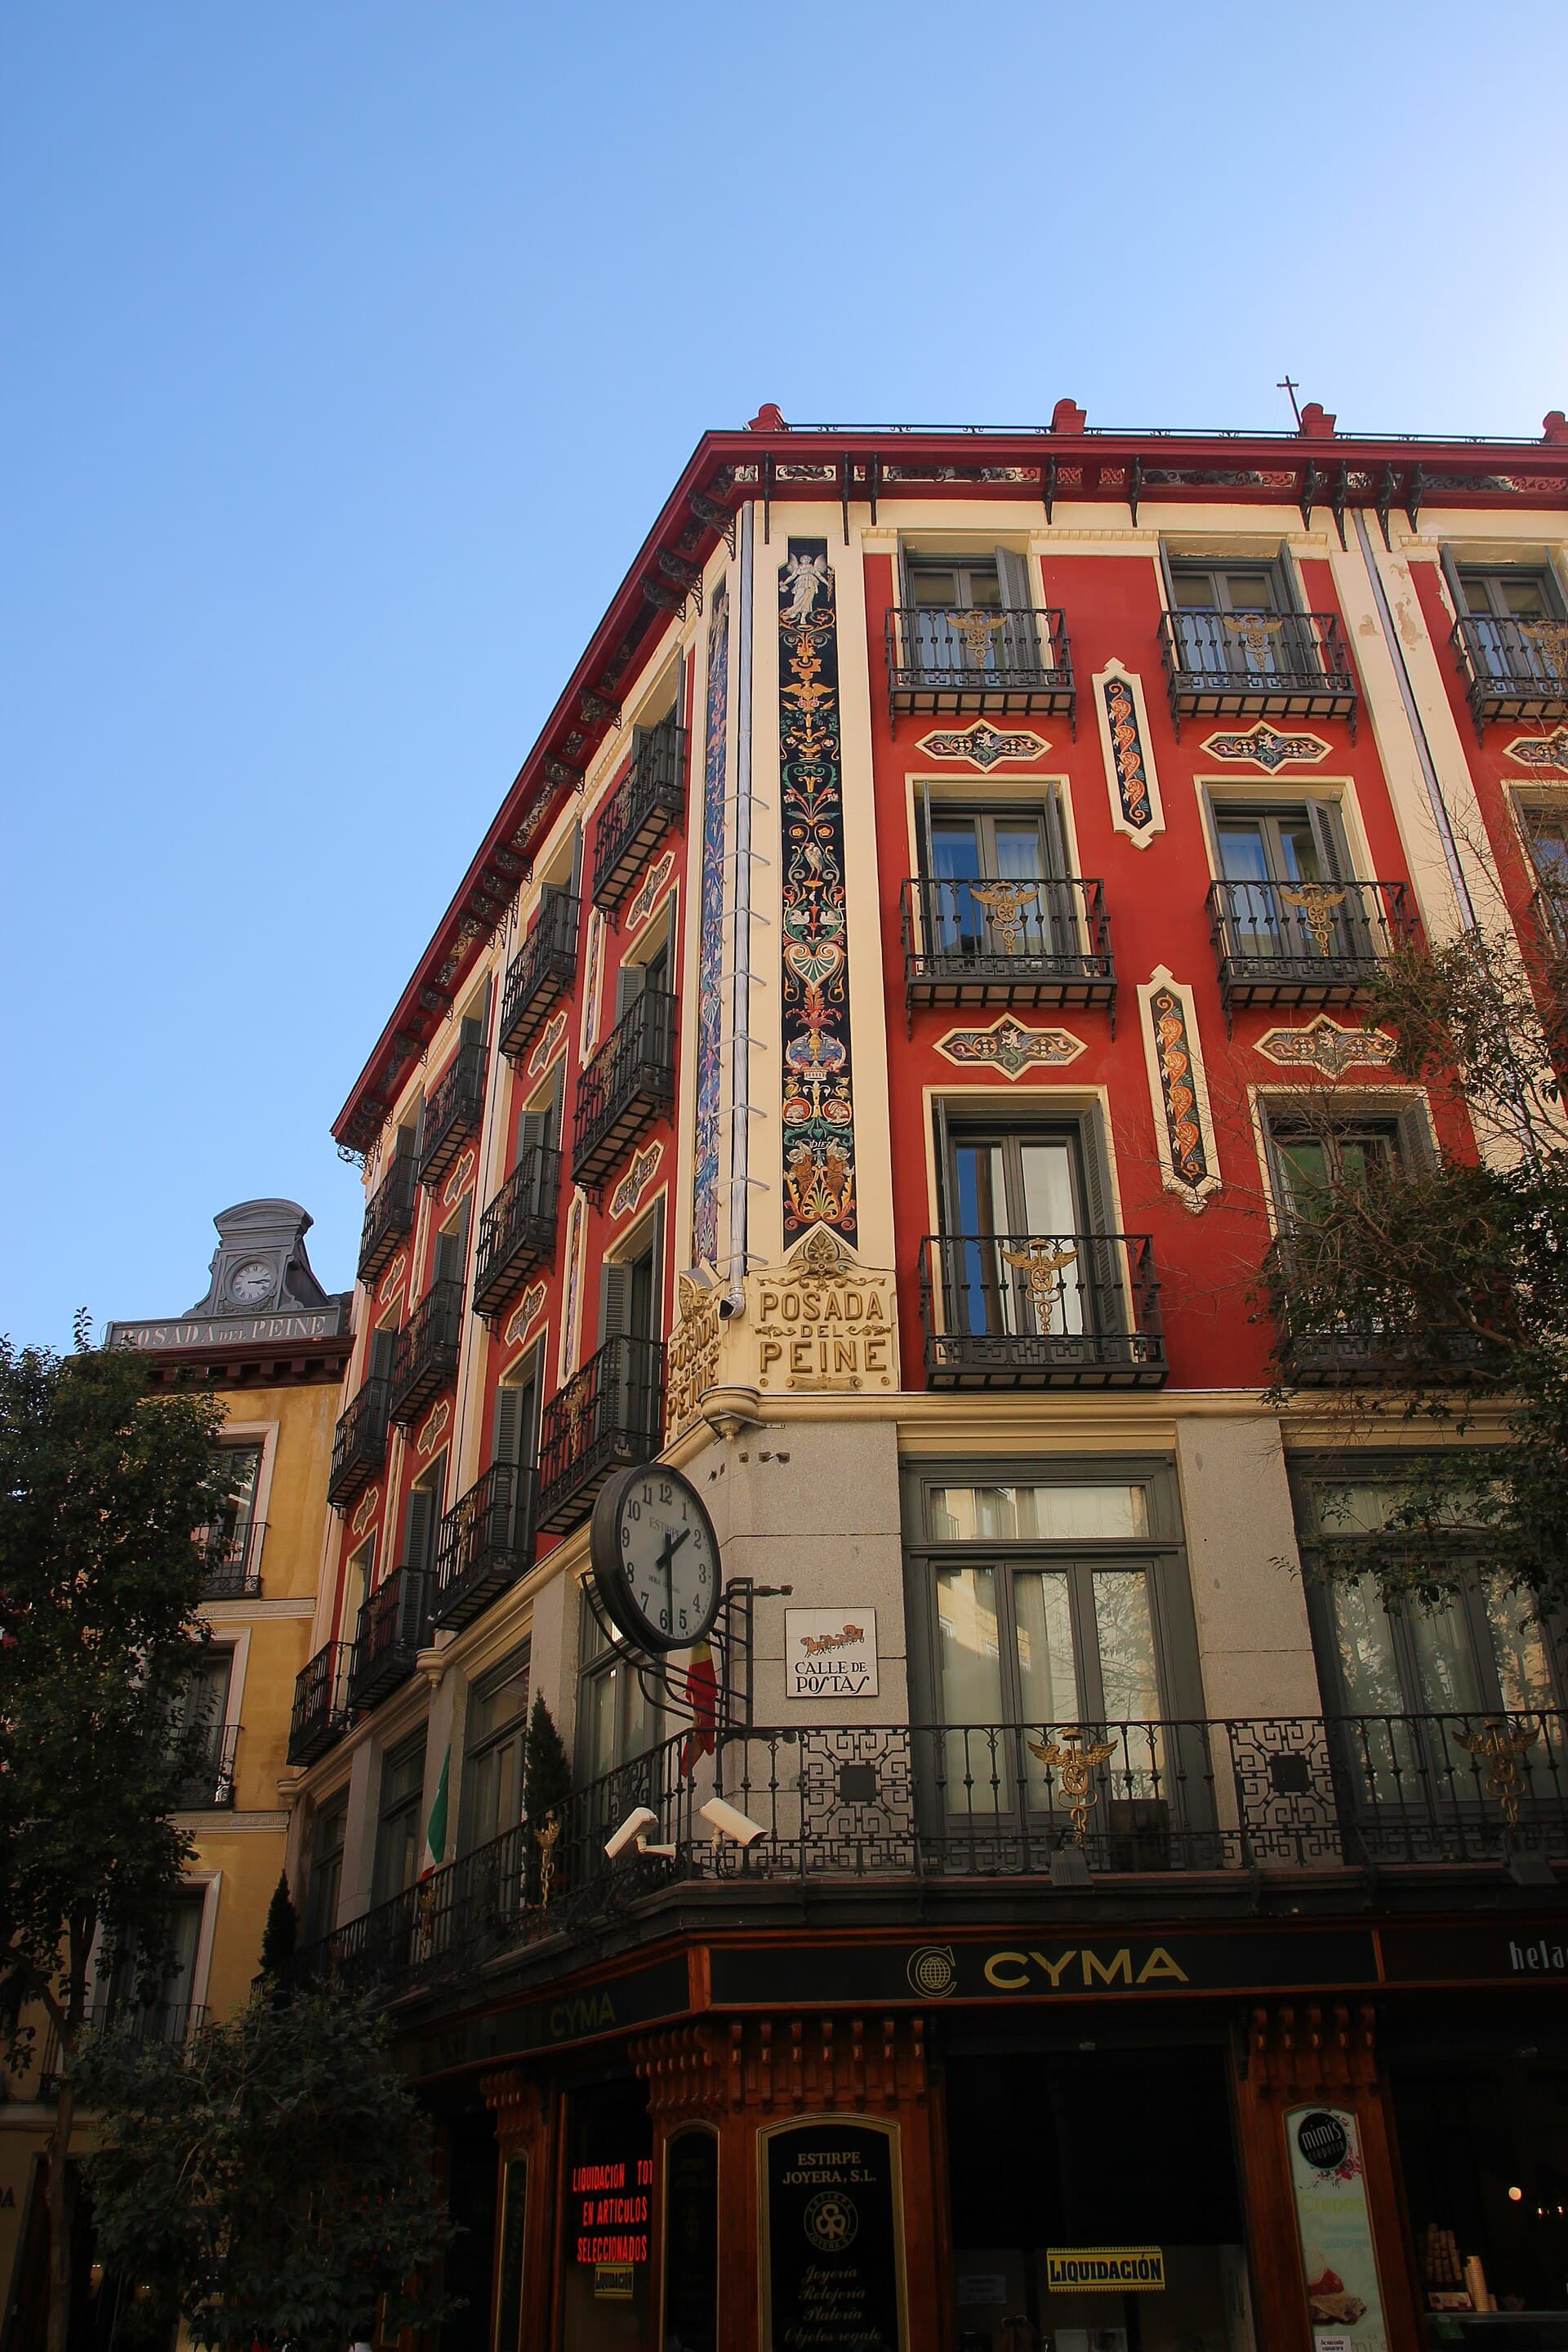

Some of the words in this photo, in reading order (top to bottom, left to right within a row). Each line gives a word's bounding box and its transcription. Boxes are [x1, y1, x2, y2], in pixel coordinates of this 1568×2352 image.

[760, 1291, 884, 1321] POSADA
[218, 1330, 247, 1342] DEL
[252, 1315, 327, 1339] PEINE
[800, 1324, 844, 1338] DEL
[760, 1339, 888, 1374] PEINE
[643, 1484, 653, 1505] 11
[659, 1483, 673, 1506] 12
[627, 1499, 641, 1521] 10
[681, 1502, 688, 1521] 1
[621, 1526, 630, 1548] 9
[693, 1529, 702, 1550] 2
[626, 1561, 635, 1584] 8
[698, 1563, 706, 1584] 3
[640, 1592, 650, 1613] 7
[692, 1593, 701, 1614] 4
[659, 1609, 668, 1630] 6
[679, 1609, 687, 1629] 5
[795, 1660, 849, 1675] CALLE
[852, 1661, 867, 1673] DE
[795, 1676, 870, 1695] POSTAS
[1509, 1940, 1568, 1971] hela
[984, 1947, 1190, 1989] CYMA
[550, 1988, 617, 2038] CYMA
[797, 2150, 862, 2166] ESTIRPE
[572, 2163, 626, 2193] LIQUIDACION
[782, 2169, 848, 2185] JOYERA,
[850, 2168, 877, 2183] S.L.
[582, 2200, 595, 2228] EN
[596, 2195, 648, 2227] ARTICULOS
[577, 2234, 648, 2265] SELECCIONADOS
[1049, 2253, 1162, 2283] LIQUIDACIÓN
